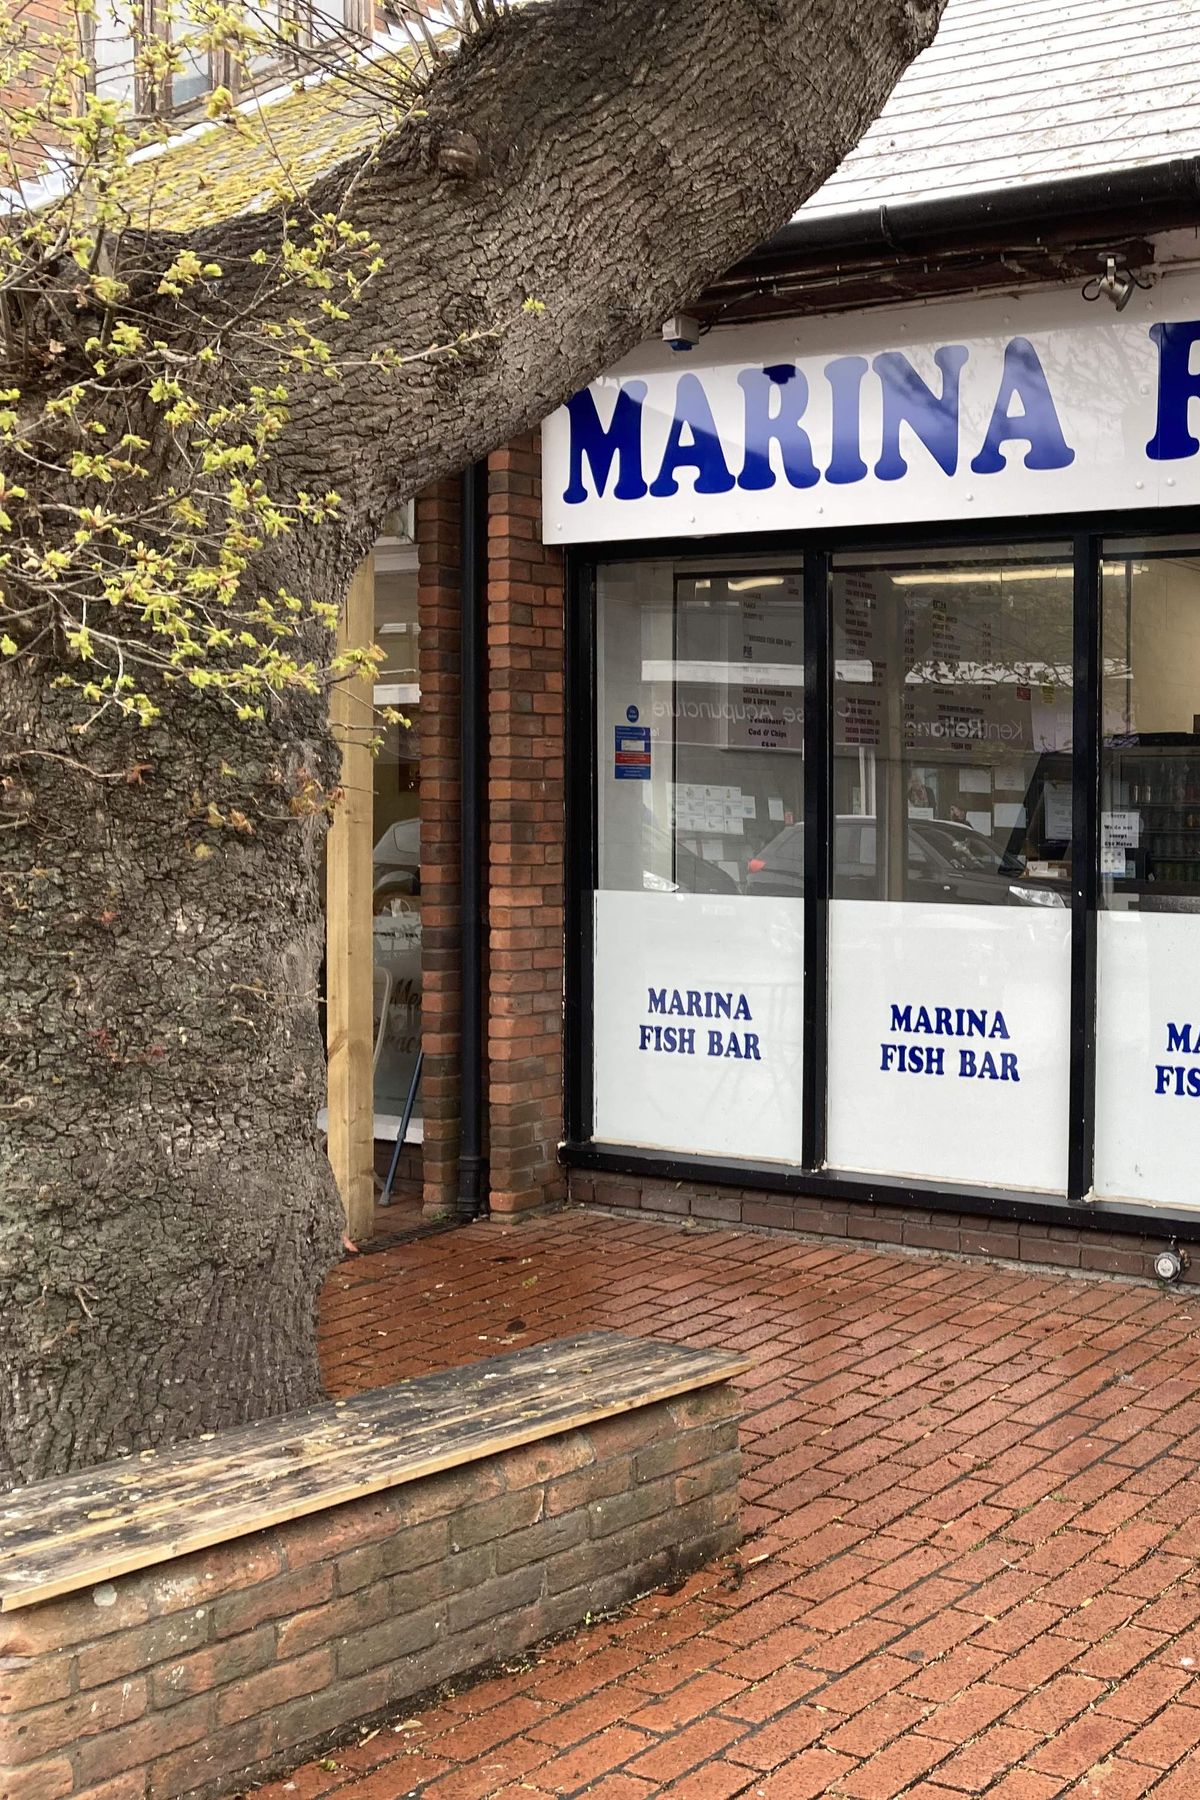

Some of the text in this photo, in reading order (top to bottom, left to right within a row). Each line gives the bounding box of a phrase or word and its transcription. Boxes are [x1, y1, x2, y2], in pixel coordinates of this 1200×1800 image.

[563, 336, 1075, 505] MARINA
[770, 730, 787, 739] Chips
[648, 988, 752, 1021] MARINA
[889, 1004, 1010, 1040] MARINA
[639, 1025, 762, 1060] FISH BAR
[880, 1043, 1021, 1082] FISH BAR
